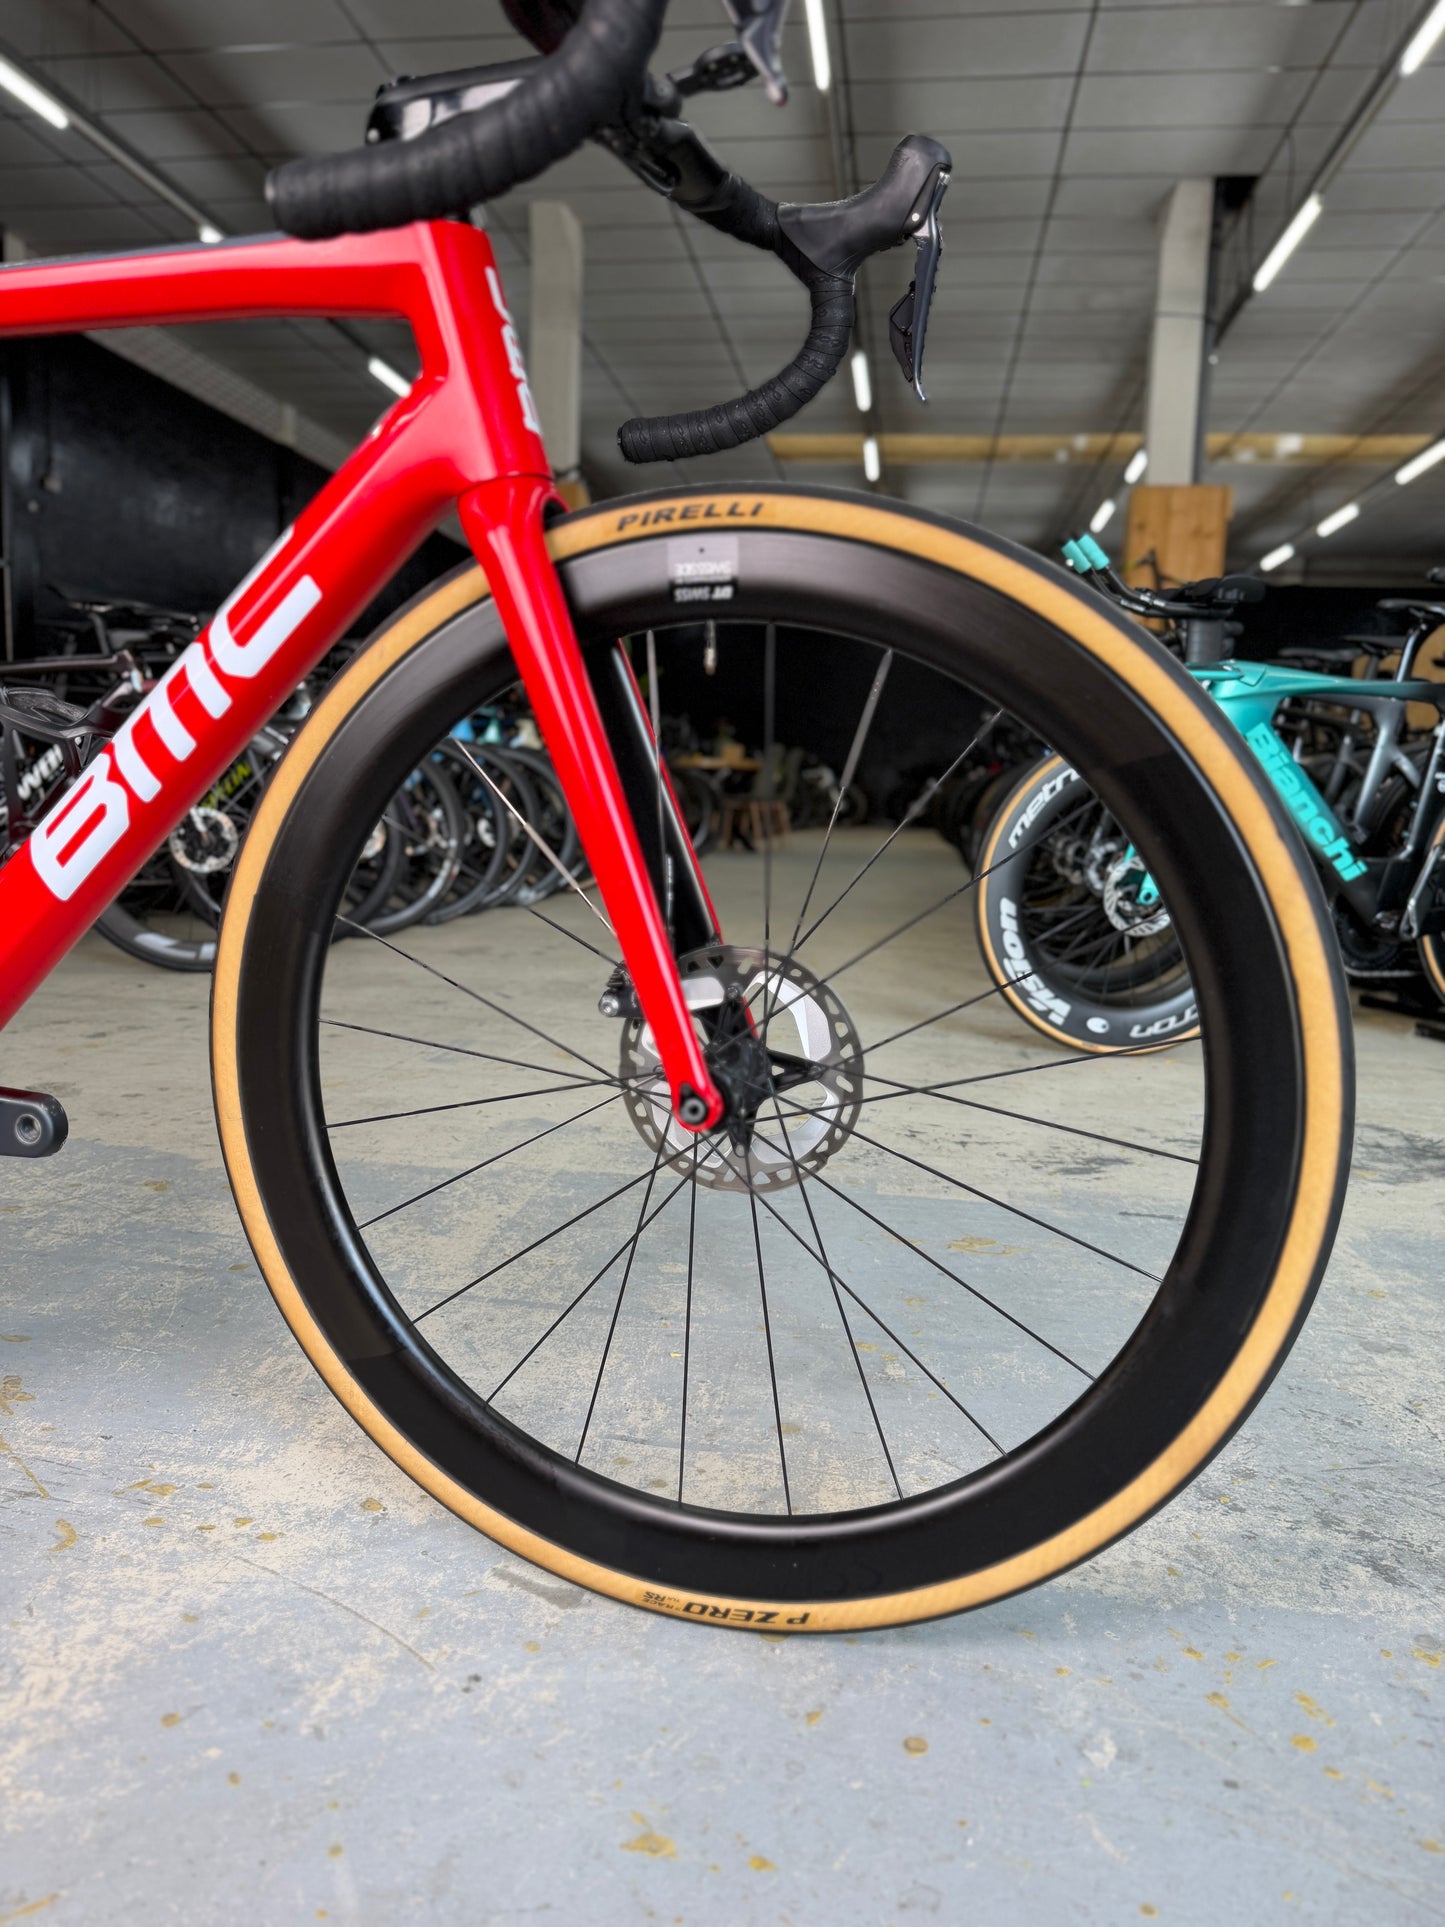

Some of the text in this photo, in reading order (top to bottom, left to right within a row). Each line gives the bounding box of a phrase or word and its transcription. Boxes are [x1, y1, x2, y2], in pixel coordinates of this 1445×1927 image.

[617, 502, 764, 532] PIRELLI
[30, 525, 323, 901] BMC
[1008, 762, 1082, 850] metr
[1246, 722, 1369, 884] Bianchi
[641, 1597, 811, 1625] P ZERO RACE
[643, 1590, 666, 1602] RS
